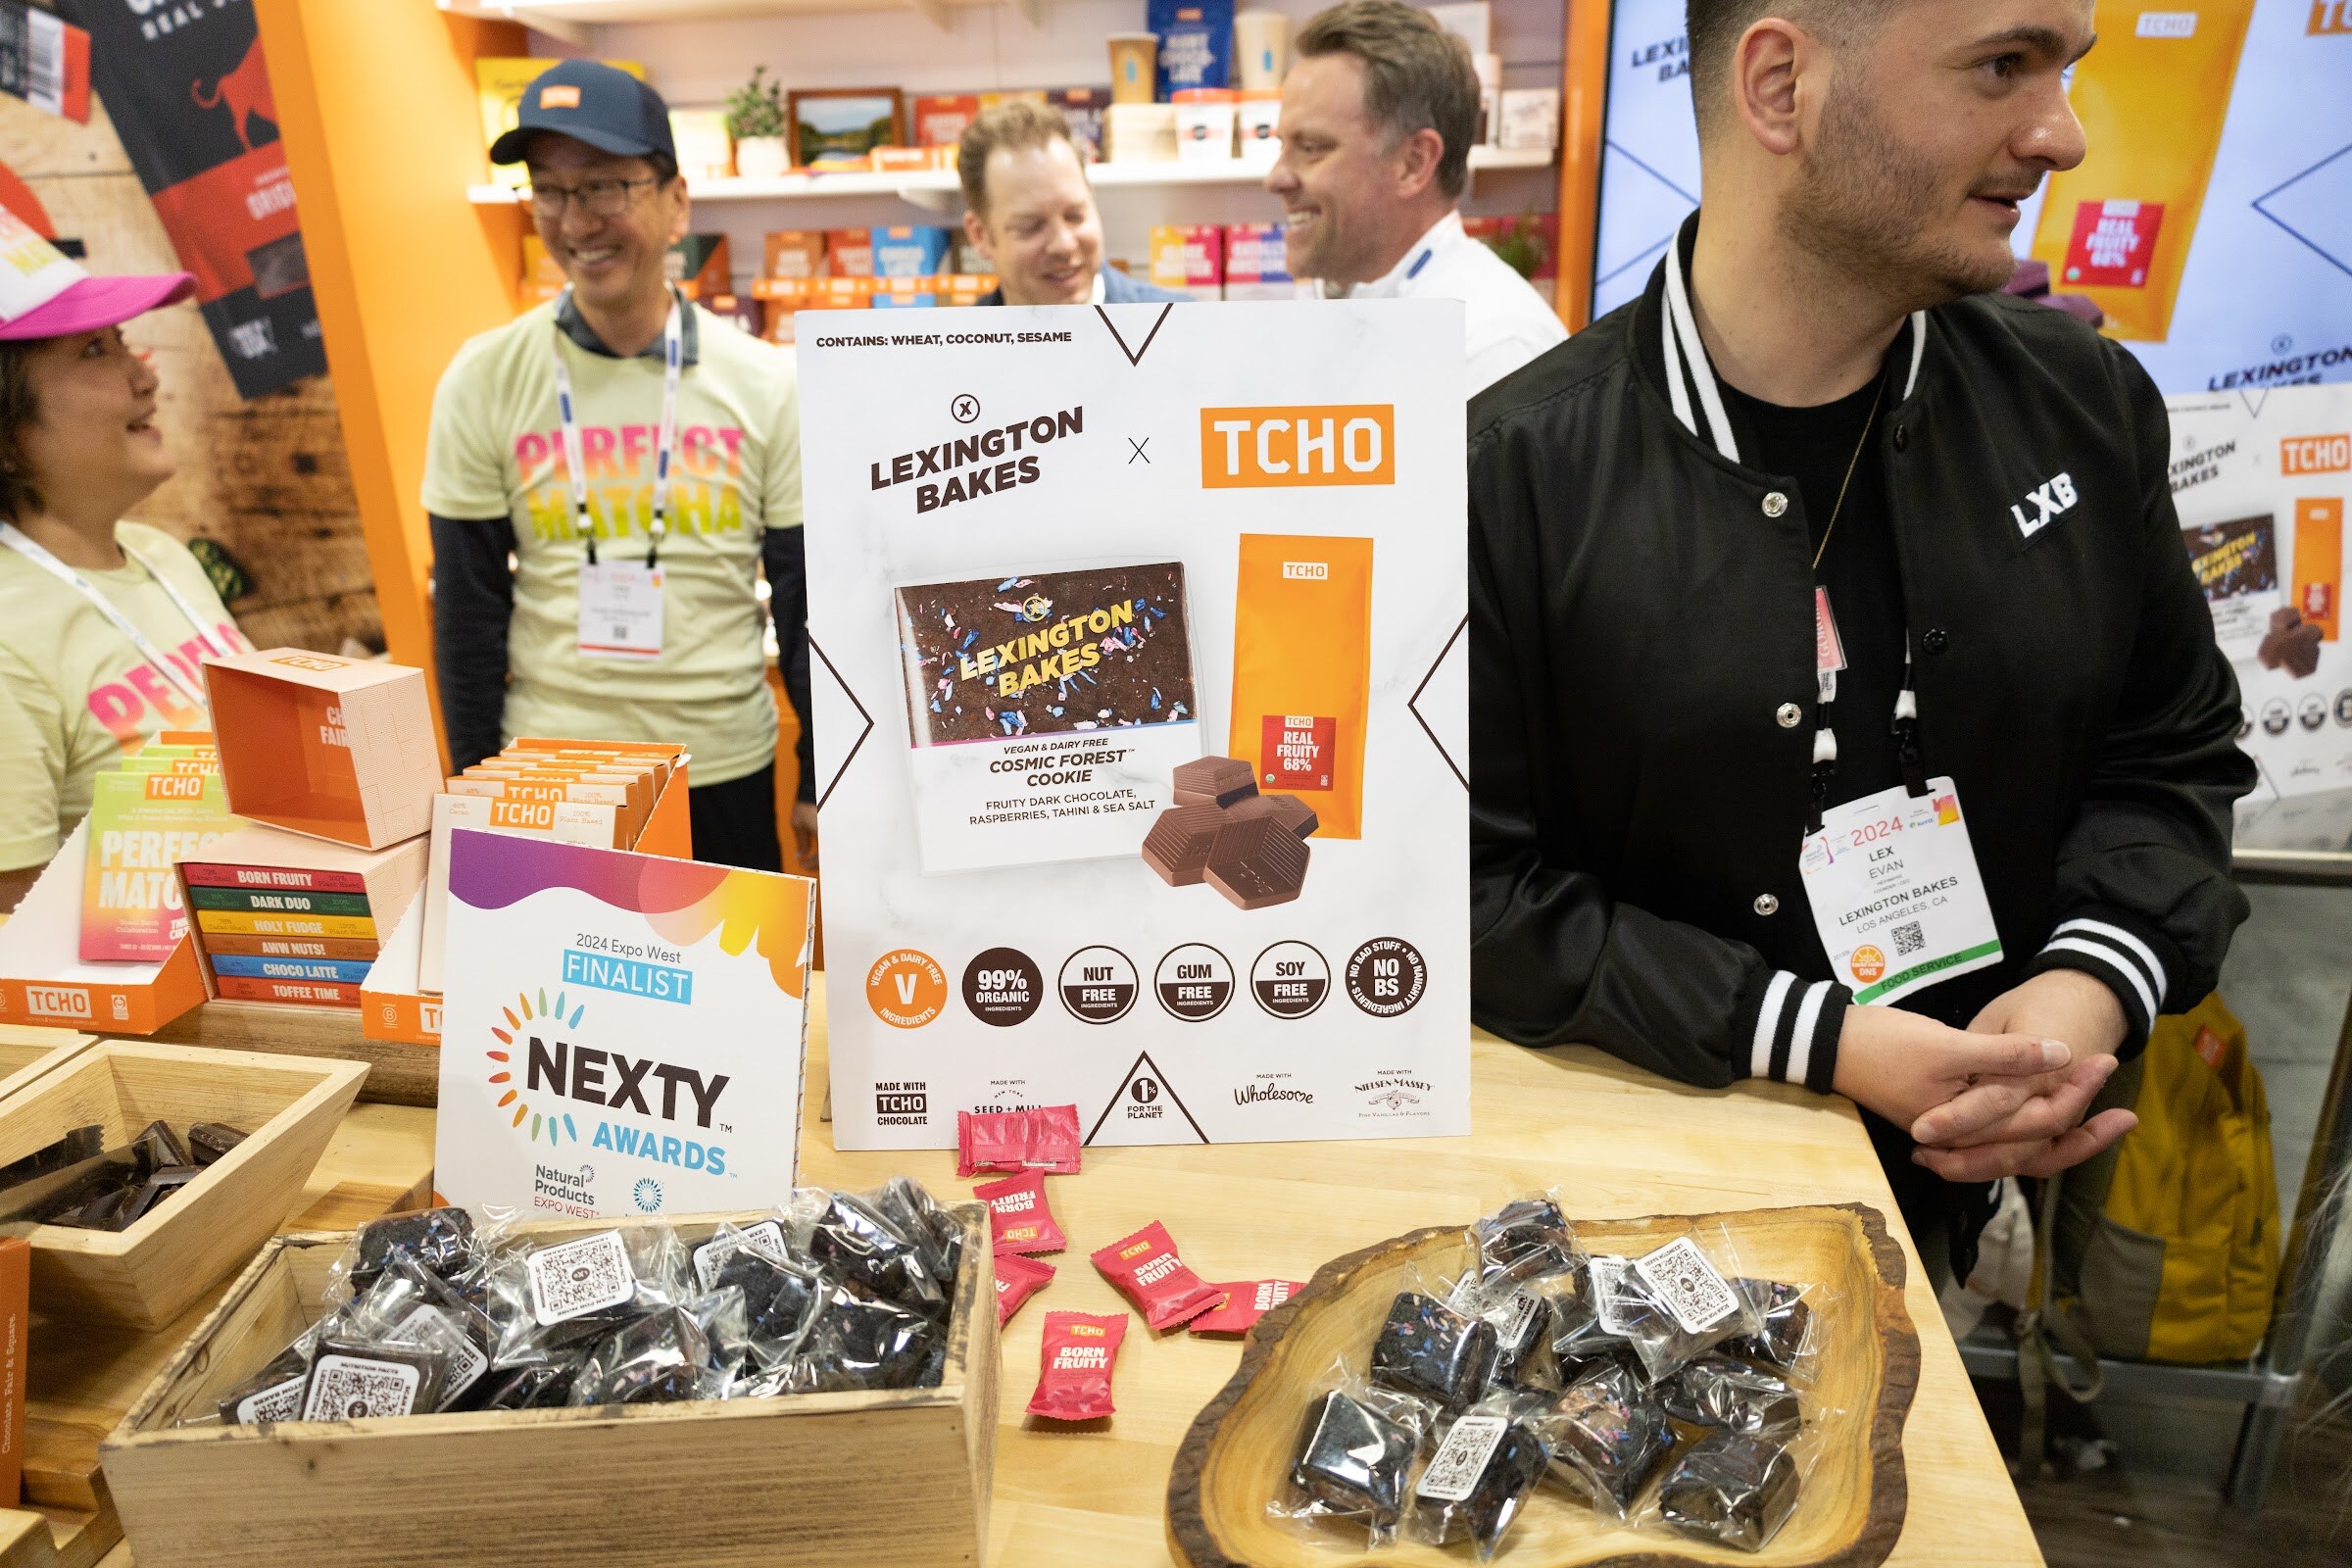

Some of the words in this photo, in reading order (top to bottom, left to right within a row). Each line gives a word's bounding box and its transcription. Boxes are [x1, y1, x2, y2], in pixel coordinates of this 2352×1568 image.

[2143, 17, 2191, 33] TCHO
[816, 336, 889, 348] CONTAINS:
[891, 334, 944, 347] WHEAT,
[946, 333, 1015, 346] COCONUT,
[1017, 331, 1072, 343] SESAME
[871, 405, 1084, 492] LEXINGTON
[1213, 417, 1383, 476] TCHO
[2284, 440, 2346, 471] TCHO
[916, 456, 1041, 514] BAKES
[2011, 472, 2079, 538] LXB
[1286, 564, 1325, 577] TCHO
[959, 599, 1134, 682] LEXINGTON
[999, 642, 1101, 698] BAKES
[1287, 716, 1311, 727] TCHO
[1004, 744, 1039, 755] VEGAN
[1041, 743, 1048, 752] &
[1050, 740, 1082, 751] DAIRY
[1083, 738, 1109, 747] FREE
[1283, 731, 1314, 745] REAL
[1276, 744, 1319, 759] FRUITY
[990, 756, 1055, 773] COSMIC
[1283, 758, 1312, 772] 68%
[150, 776, 201, 796] TCHO
[1027, 769, 1092, 787] COOKIE
[986, 799, 1026, 810] FRUITY
[1029, 795, 1061, 807] DARK
[1064, 788, 1137, 804] CHOCOLATE,
[495, 802, 551, 826] TCHO
[969, 809, 1050, 825] RASPBERRIES,
[1052, 806, 1090, 817] TAHINI
[1093, 805, 1101, 813] &
[1103, 802, 1125, 812] SEA
[1128, 800, 1155, 810] SALT
[1850, 816, 1904, 847] 2024
[101, 830, 220, 868] PERFE
[1869, 846, 1895, 862] LEX
[1869, 858, 1904, 879] EVAN
[237, 870, 271, 885] BORN
[273, 871, 313, 887] FRUITY
[99, 870, 183, 910] MATC
[250, 895, 284, 908] DARK
[285, 897, 312, 910] DUO
[1838, 891, 1909, 926] LEXINGTON
[1912, 876, 1958, 898] BAKES
[1856, 919, 1877, 934] LOS
[1878, 902, 1931, 926] ANGELES,
[1932, 896, 1948, 906] CA
[254, 919, 284, 933] HOLY
[285, 921, 324, 934] FUDGE
[262, 942, 290, 955] AWW
[291, 943, 326, 956] NUTS!
[576, 934, 609, 951] 2024
[611, 939, 643, 959] Expo
[646, 945, 681, 964] West
[1372, 940, 1401, 953] STUFF
[1354, 947, 1373, 965] BAD
[1405, 951, 1419, 965] NO
[263, 963, 304, 977] CHOCO
[306, 964, 339, 979] LATTE
[870, 959, 892, 986] VEGAN
[891, 955, 900, 963] &
[900, 953, 928, 966] DAIRY
[925, 962, 943, 986] FREE
[1083, 966, 1114, 982] NUT
[1177, 964, 1212, 979] GUM
[1275, 961, 1305, 977] SOY
[1348, 964, 1360, 978] NO
[1373, 958, 1399, 977] NO
[1859, 967, 1878, 977] DNS
[1881, 971, 1910, 992] FOOD
[1912, 954, 1963, 978] SERVICE
[566, 955, 689, 999] FINALIST
[977, 969, 1028, 991] 99%
[1403, 965, 1423, 1005] NAUGHTY
[272, 985, 313, 999] TOFFEE
[314, 987, 341, 1001] TIME
[895, 973, 917, 1004] V
[1082, 988, 1116, 1002] FREE
[1177, 986, 1212, 1000] FREE
[1274, 983, 1308, 998] FREE
[1374, 978, 1399, 997] BS
[30, 990, 87, 1012] TCHO
[975, 991, 1030, 1004] ORGANIC
[1350, 986, 1405, 1014] INGREDIENTS
[880, 1005, 936, 1026] INGREDIENTS
[875, 1082, 901, 1091] MADE
[903, 1082, 926, 1091] WITH
[880, 1096, 924, 1111] TCHO
[974, 1105, 1004, 1114] SEED
[877, 1115, 928, 1126] CHOCOLATE
[535, 1163, 585, 1188] Natural
[535, 1179, 595, 1206] Products
[990, 1190, 1036, 1208] FRUITY
[534, 1196, 564, 1212] EXPO
[996, 1200, 1035, 1213] BORN
[1006, 1227, 1037, 1240] TCHO
[1120, 1241, 1150, 1259] TCHO
[1134, 1252, 1176, 1276] BORN
[1135, 1257, 1183, 1287] FRUITY
[1253, 1282, 1273, 1310] BORN
[1072, 1325, 1103, 1336] TCHO
[1059, 1347, 1105, 1357] BORN
[1053, 1356, 1108, 1369] FRUITY
